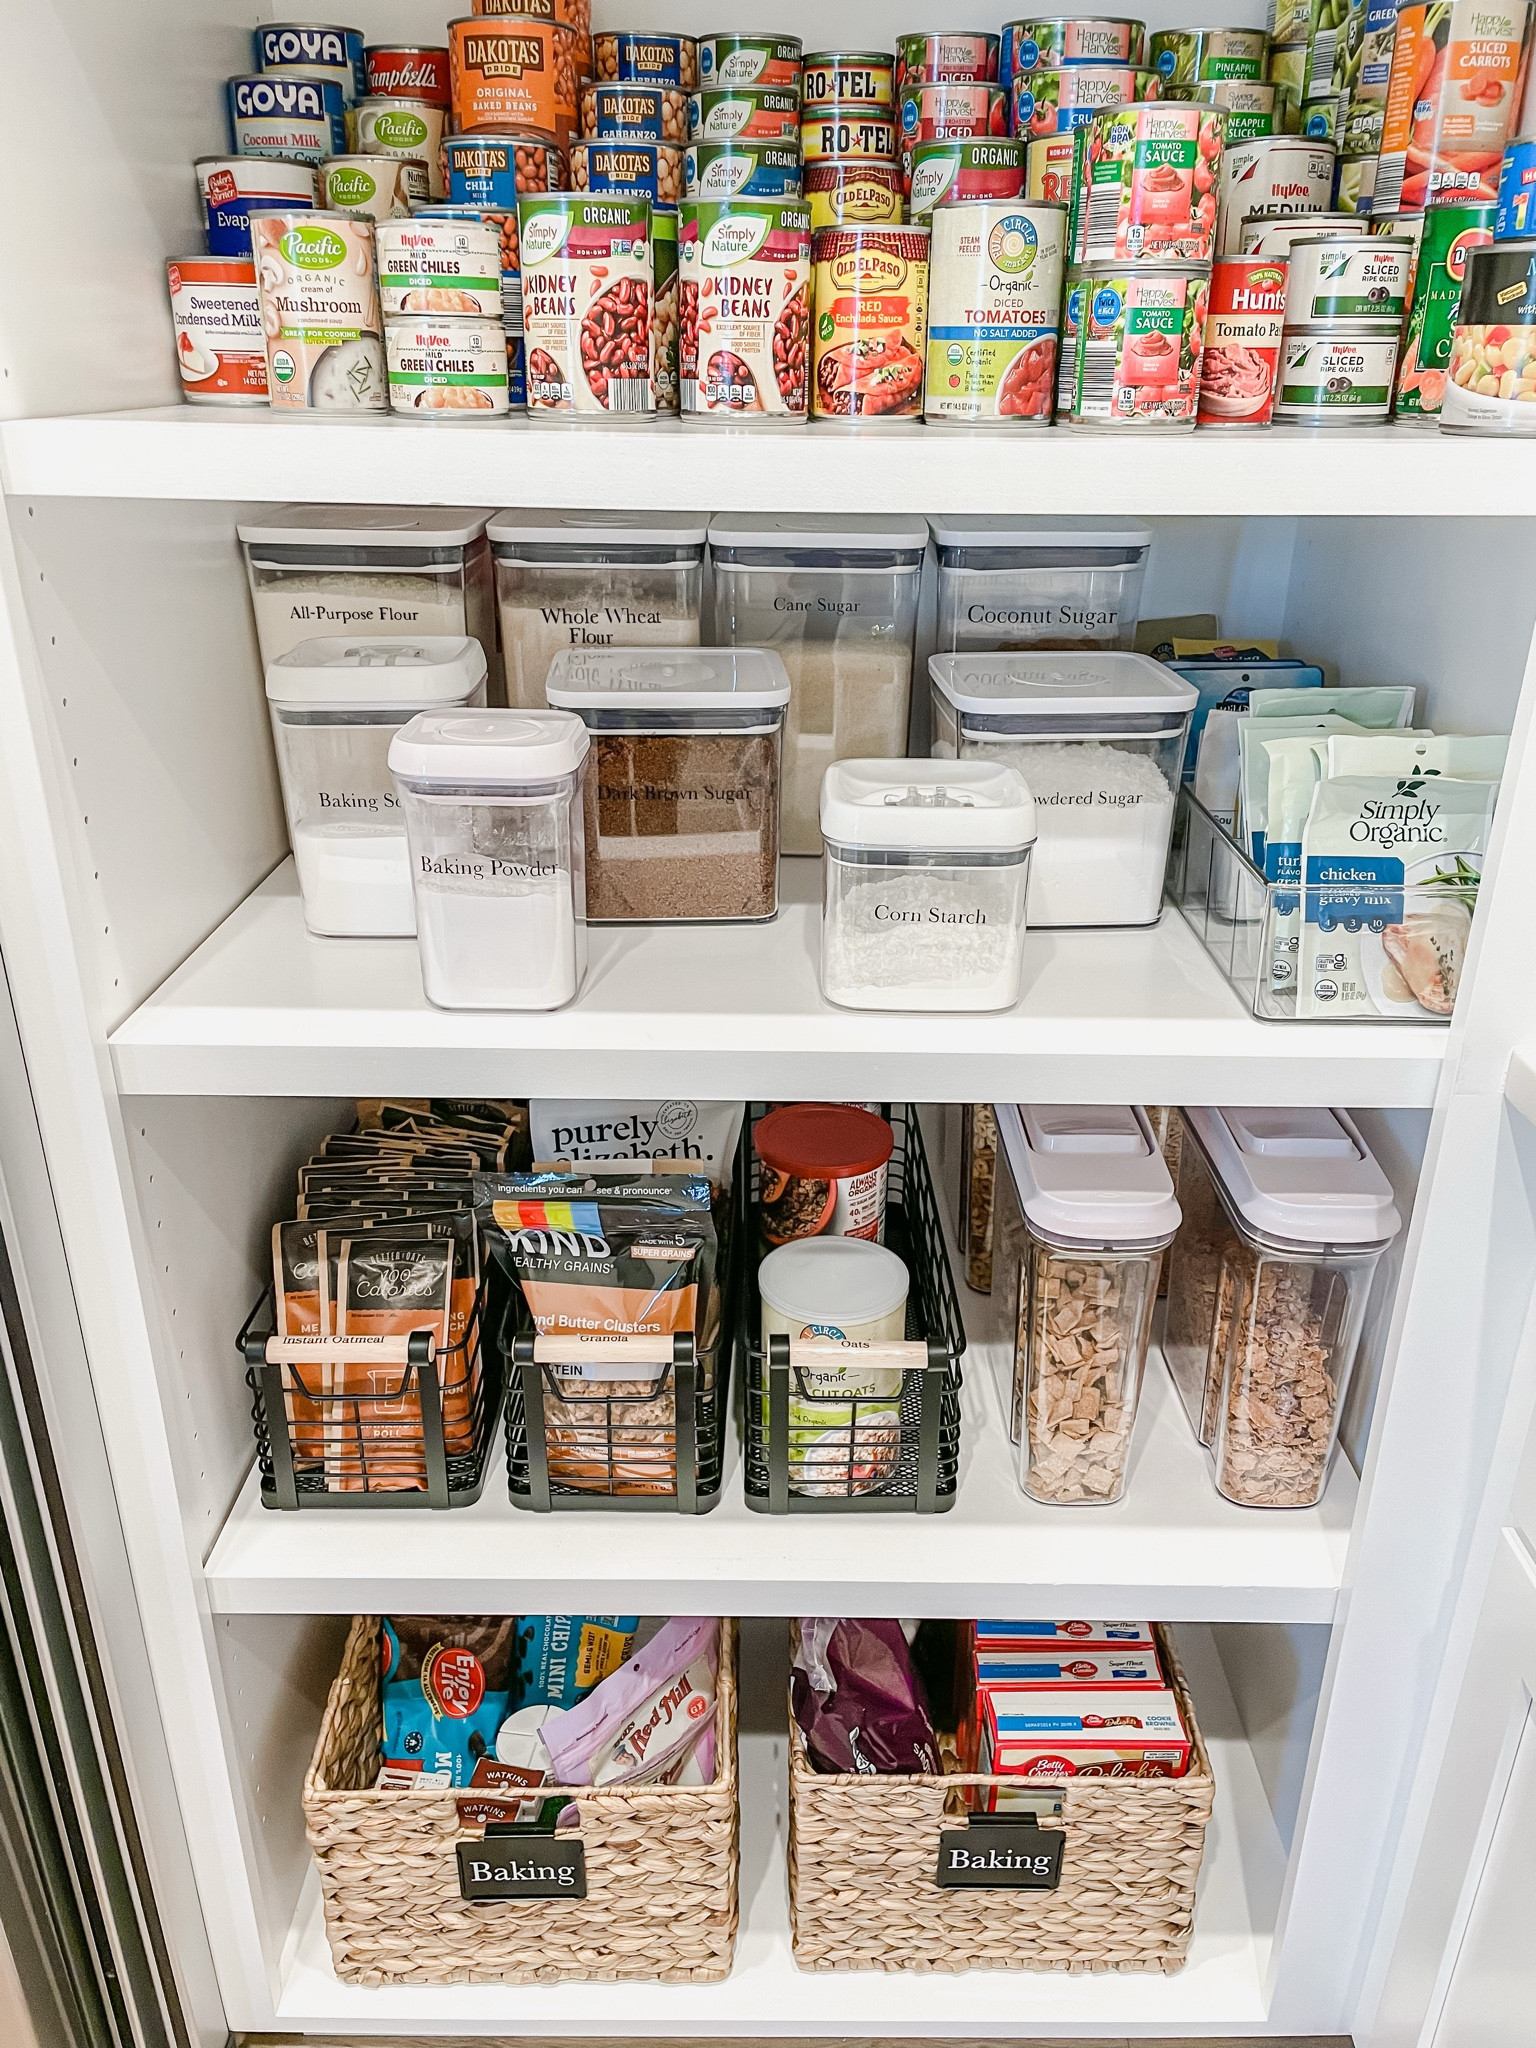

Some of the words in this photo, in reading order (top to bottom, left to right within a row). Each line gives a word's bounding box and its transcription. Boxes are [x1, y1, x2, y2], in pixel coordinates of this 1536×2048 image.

[1369, 8, 1397, 21] GREEN
[1077, 29, 1113, 45] Happy
[265, 31, 345, 62] GOYA
[468, 39, 540, 64] DAKOTA'S
[1470, 42, 1507, 54] SLICED
[626, 46, 674, 63] DAKOTA'S
[730, 56, 758, 70] Simply
[1215, 63, 1255, 74] PINEAPPLE
[1460, 56, 1511, 68] CARROTS
[487, 65, 518, 74] PRIDE
[725, 69, 752, 78] Nature
[1072, 78, 1113, 93] Happy
[237, 83, 320, 115] GOYA
[476, 88, 532, 99] ORIGINAL
[473, 102, 502, 111] BAKED
[506, 102, 537, 111] BEANS
[604, 98, 655, 115] DAKOTA'S
[764, 95, 794, 112] ORGANIC
[714, 107, 743, 122] Simply
[378, 117, 423, 137] Pacific
[710, 121, 737, 131] Nature
[1146, 118, 1178, 130] Happy
[936, 127, 972, 138] DICED
[1111, 133, 1129, 143] BPA
[1150, 128, 1187, 138] Harvest
[1228, 128, 1256, 137] SLICES
[242, 133, 288, 147] Coconut
[291, 133, 321, 147] Milk
[1152, 142, 1181, 150] TOMATO
[454, 148, 506, 167] DAKOTA'S
[595, 154, 650, 172] DAKOTA'S
[766, 151, 797, 168] ORGANIC
[972, 148, 1019, 166] ORGANIC
[1145, 150, 1185, 162] SAUCE
[466, 168, 491, 177] PRIDE
[610, 172, 635, 180] PRIDE
[711, 164, 742, 179] Simply
[915, 170, 944, 186] Simply
[330, 174, 371, 192] Pacific
[465, 182, 493, 191] CHILI
[707, 178, 736, 188] Nature
[913, 186, 936, 197] Nature
[583, 207, 630, 225] ORGANIC
[529, 223, 557, 240] Simply
[718, 224, 756, 242] Simply
[1004, 219, 1035, 243] CIRCLE
[1131, 228, 1140, 238] 15
[284, 233, 342, 254] Pacific
[1321, 251, 1347, 261] simple
[388, 260, 417, 273] GREEN
[421, 261, 460, 274] CHILES
[1364, 265, 1399, 274] SLICED
[288, 274, 345, 286] ORGANIC
[528, 275, 577, 294] KIDNEY
[714, 276, 772, 296] KIDNEY
[989, 275, 1032, 295] Organic
[1136, 288, 1167, 300] Happy
[191, 297, 259, 311] Sweetened
[276, 297, 362, 314] Mushroom
[534, 297, 575, 316] BEANS
[721, 299, 770, 318] BEANS
[860, 302, 881, 311] RED
[994, 299, 1024, 307] DICED
[1140, 298, 1177, 307] Harvest
[176, 313, 231, 325] Condensed
[232, 314, 261, 327] Milk
[878, 314, 902, 324] Sauce
[965, 310, 1045, 324] TOMATOES
[1136, 318, 1173, 329] SAUCE
[285, 330, 305, 338] GREAT
[325, 330, 357, 338] COOKING
[974, 329, 988, 337] NO
[1010, 329, 1037, 338] ADDED
[1216, 323, 1266, 336] Tomato
[401, 358, 433, 372] GREEN
[436, 360, 474, 372] CHILES
[1322, 357, 1364, 365] SLICED
[1123, 390, 1132, 399] 15
[773, 597, 812, 612] Cane
[817, 597, 860, 615] Sugar
[290, 606, 373, 624] All-Purpose
[379, 607, 419, 621] Flour
[539, 608, 599, 625] Whole
[605, 608, 662, 624] Wheat
[967, 604, 1053, 624] Coconut
[1059, 606, 1118, 631] Sugar
[569, 628, 614, 645] Flour
[597, 785, 639, 800] Dark
[645, 786, 700, 800] Brown
[704, 786, 754, 805] Sugar
[1098, 791, 1143, 808] Sugar
[318, 793, 378, 813] Baking
[1360, 799, 1441, 826] Simply
[1350, 821, 1443, 849] Organic
[420, 855, 484, 880] Baking
[490, 860, 560, 878] Powder
[1320, 868, 1376, 881] chicken
[1319, 895, 1358, 905] gravy
[874, 904, 921, 923] Corn
[928, 907, 986, 925] Starch
[1350, 919, 1356, 927] 3
[1373, 919, 1383, 927] 10
[552, 1115, 659, 1153] purely
[498, 1184, 546, 1194] ingredients
[548, 1186, 564, 1195] you
[675, 1235, 685, 1246] 5
[633, 1248, 659, 1258] SUPER
[383, 1269, 411, 1282] 100
[356, 1281, 435, 1300] Calories
[558, 1315, 600, 1329] Butter
[603, 1319, 661, 1332] Clusters
[283, 1336, 327, 1344] Instant
[332, 1336, 385, 1344] Oatmeal
[841, 1340, 869, 1348] Oats
[441, 1662, 457, 1701] Life
[452, 1655, 475, 1714] Enjoy
[547, 1656, 566, 1699] MINI
[659, 1673, 693, 1725] Mill
[628, 1707, 662, 1761] Red
[1037, 1759, 1065, 1769] Betty
[486, 1772, 528, 1787] WATKINS
[463, 1804, 506, 1819] WATKINS
[948, 1849, 1051, 1875] Baking
[469, 1860, 575, 1886] Baking
